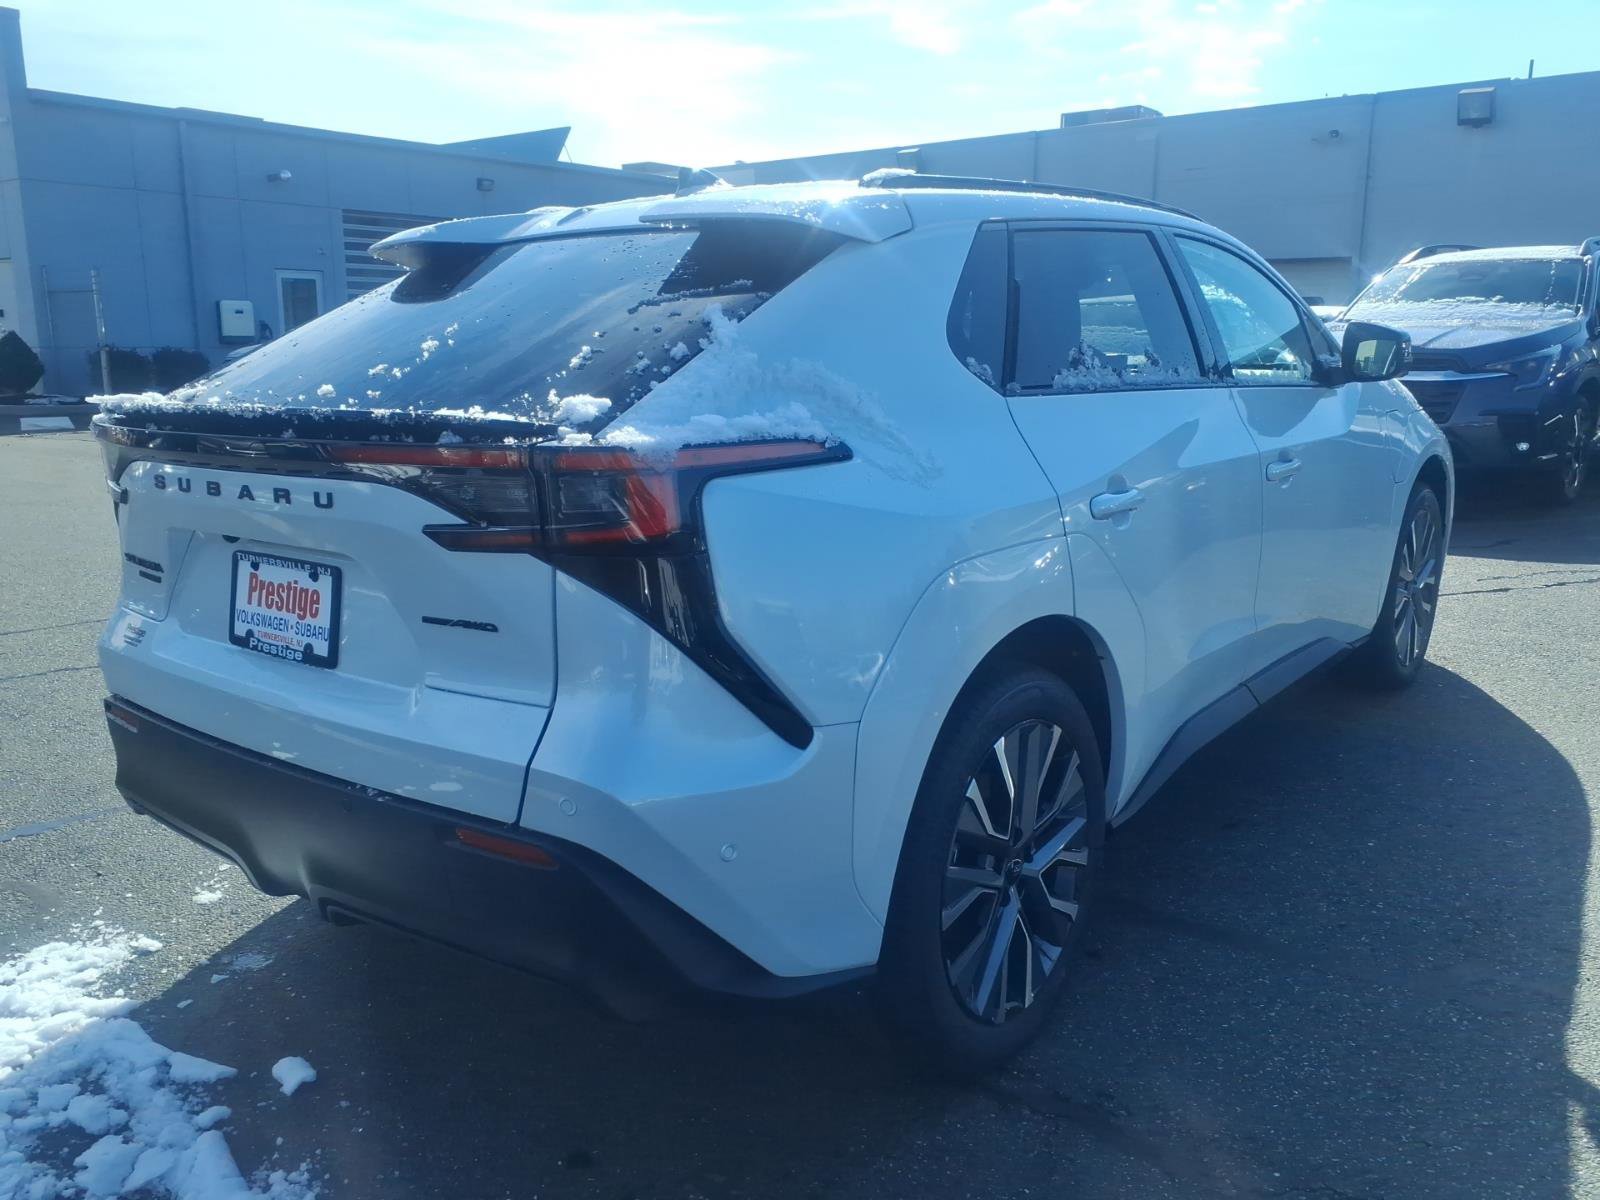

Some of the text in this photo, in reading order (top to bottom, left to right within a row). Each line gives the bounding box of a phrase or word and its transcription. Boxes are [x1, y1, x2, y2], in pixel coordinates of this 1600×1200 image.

[154, 474, 334, 509] SUBARU
[316, 567, 331, 577] NJ
[247, 572, 320, 621] Prestige
[236, 609, 330, 642] VOLKSWAGEN SUBARU
[249, 638, 303, 660] Prestige
